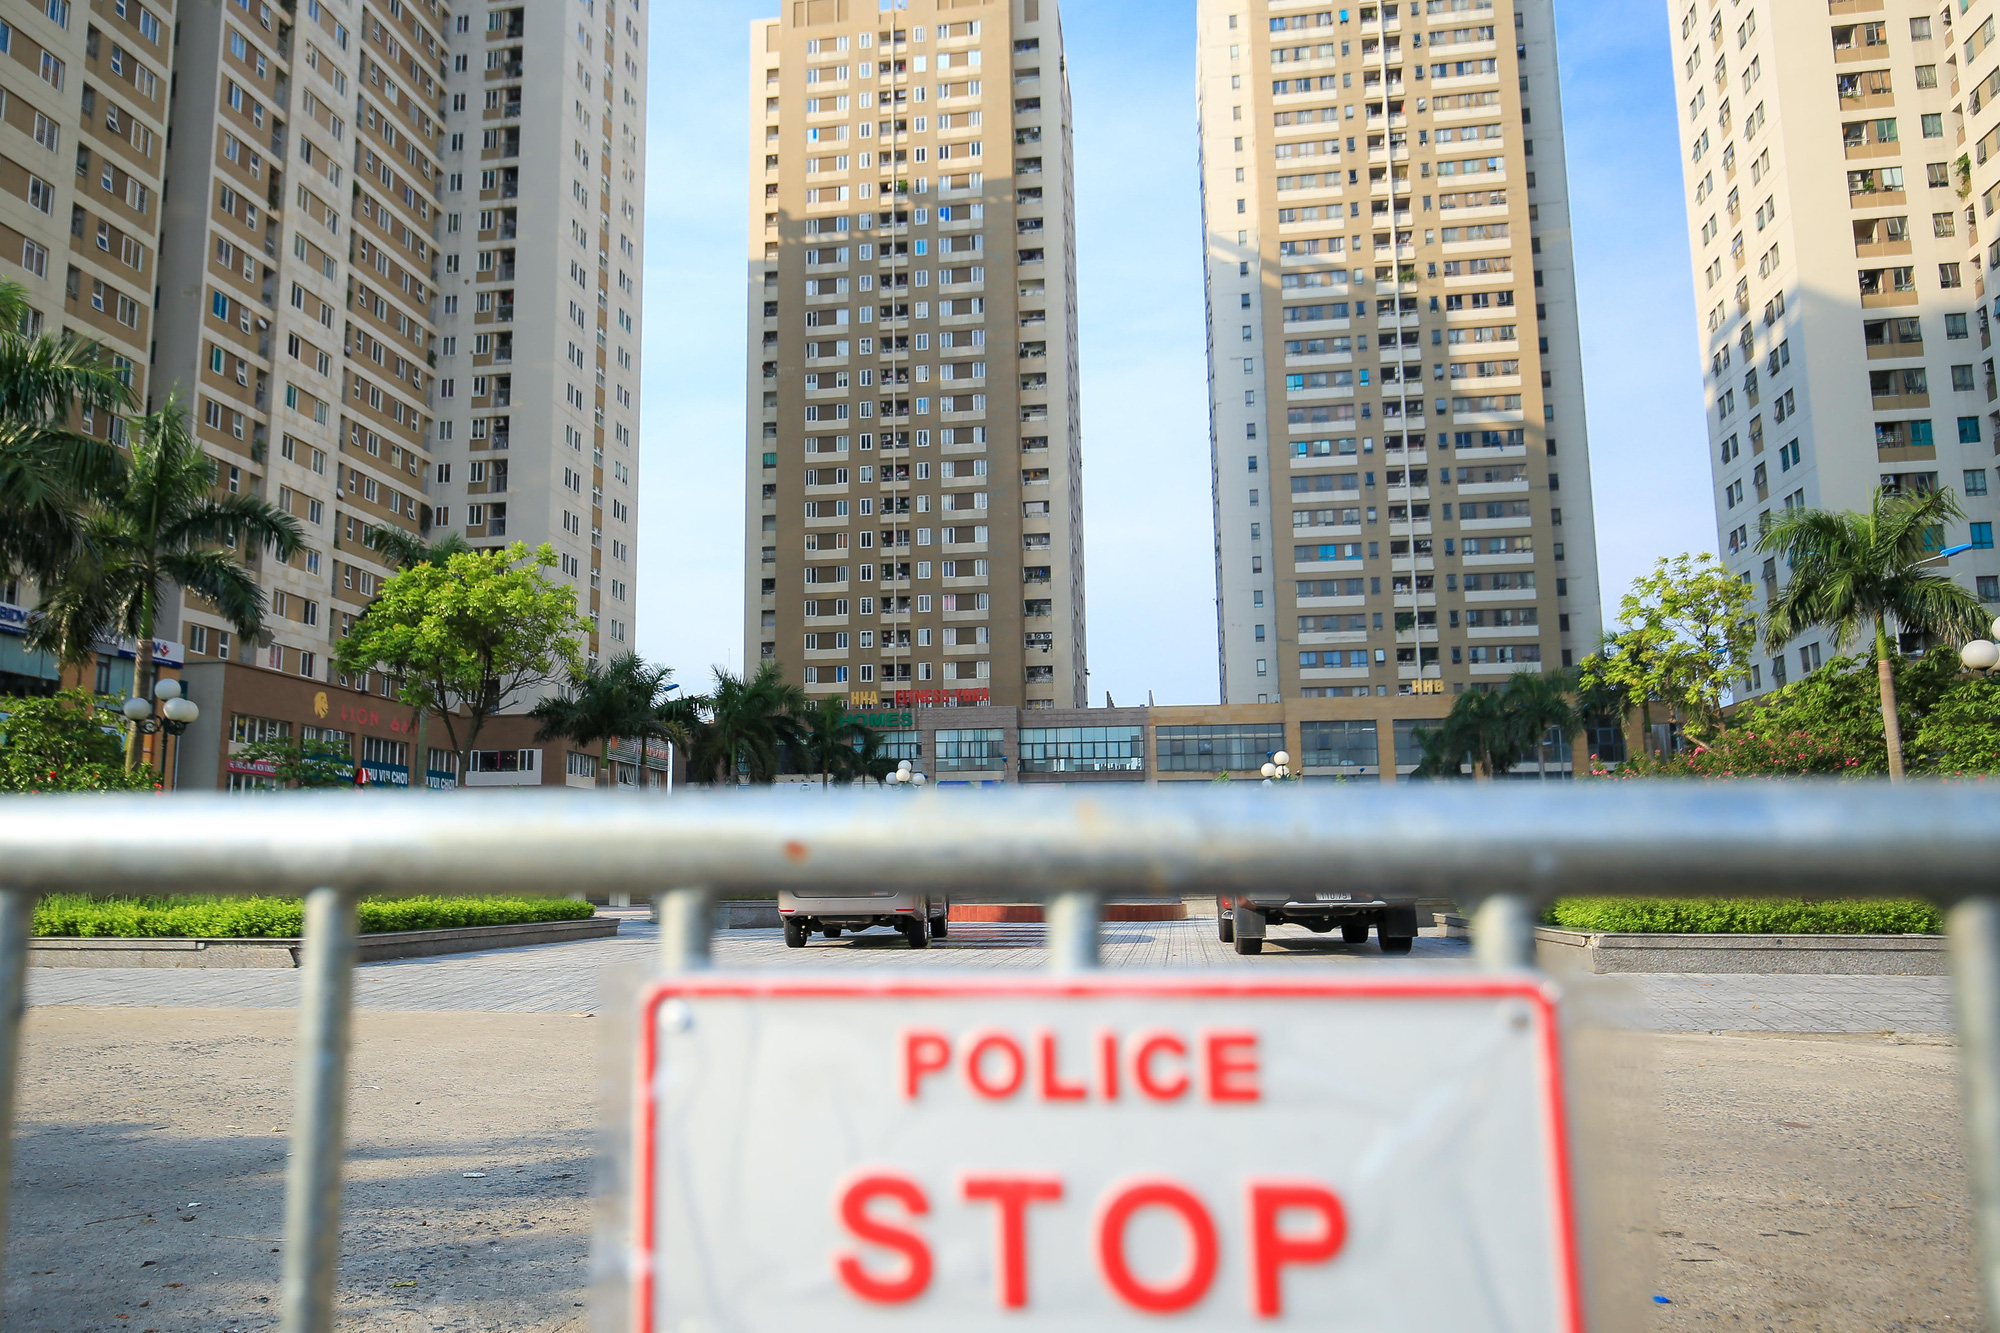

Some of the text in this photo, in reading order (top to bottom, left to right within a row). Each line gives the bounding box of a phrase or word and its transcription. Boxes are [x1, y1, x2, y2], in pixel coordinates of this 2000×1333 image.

[1411, 680, 1444, 693] HHB
[851, 691, 878, 705] HHA
[341, 704, 379, 727] LION
[839, 713, 913, 727] HOMES
[906, 1034, 1261, 1101] POLICE
[837, 1175, 1346, 1318] STOP
